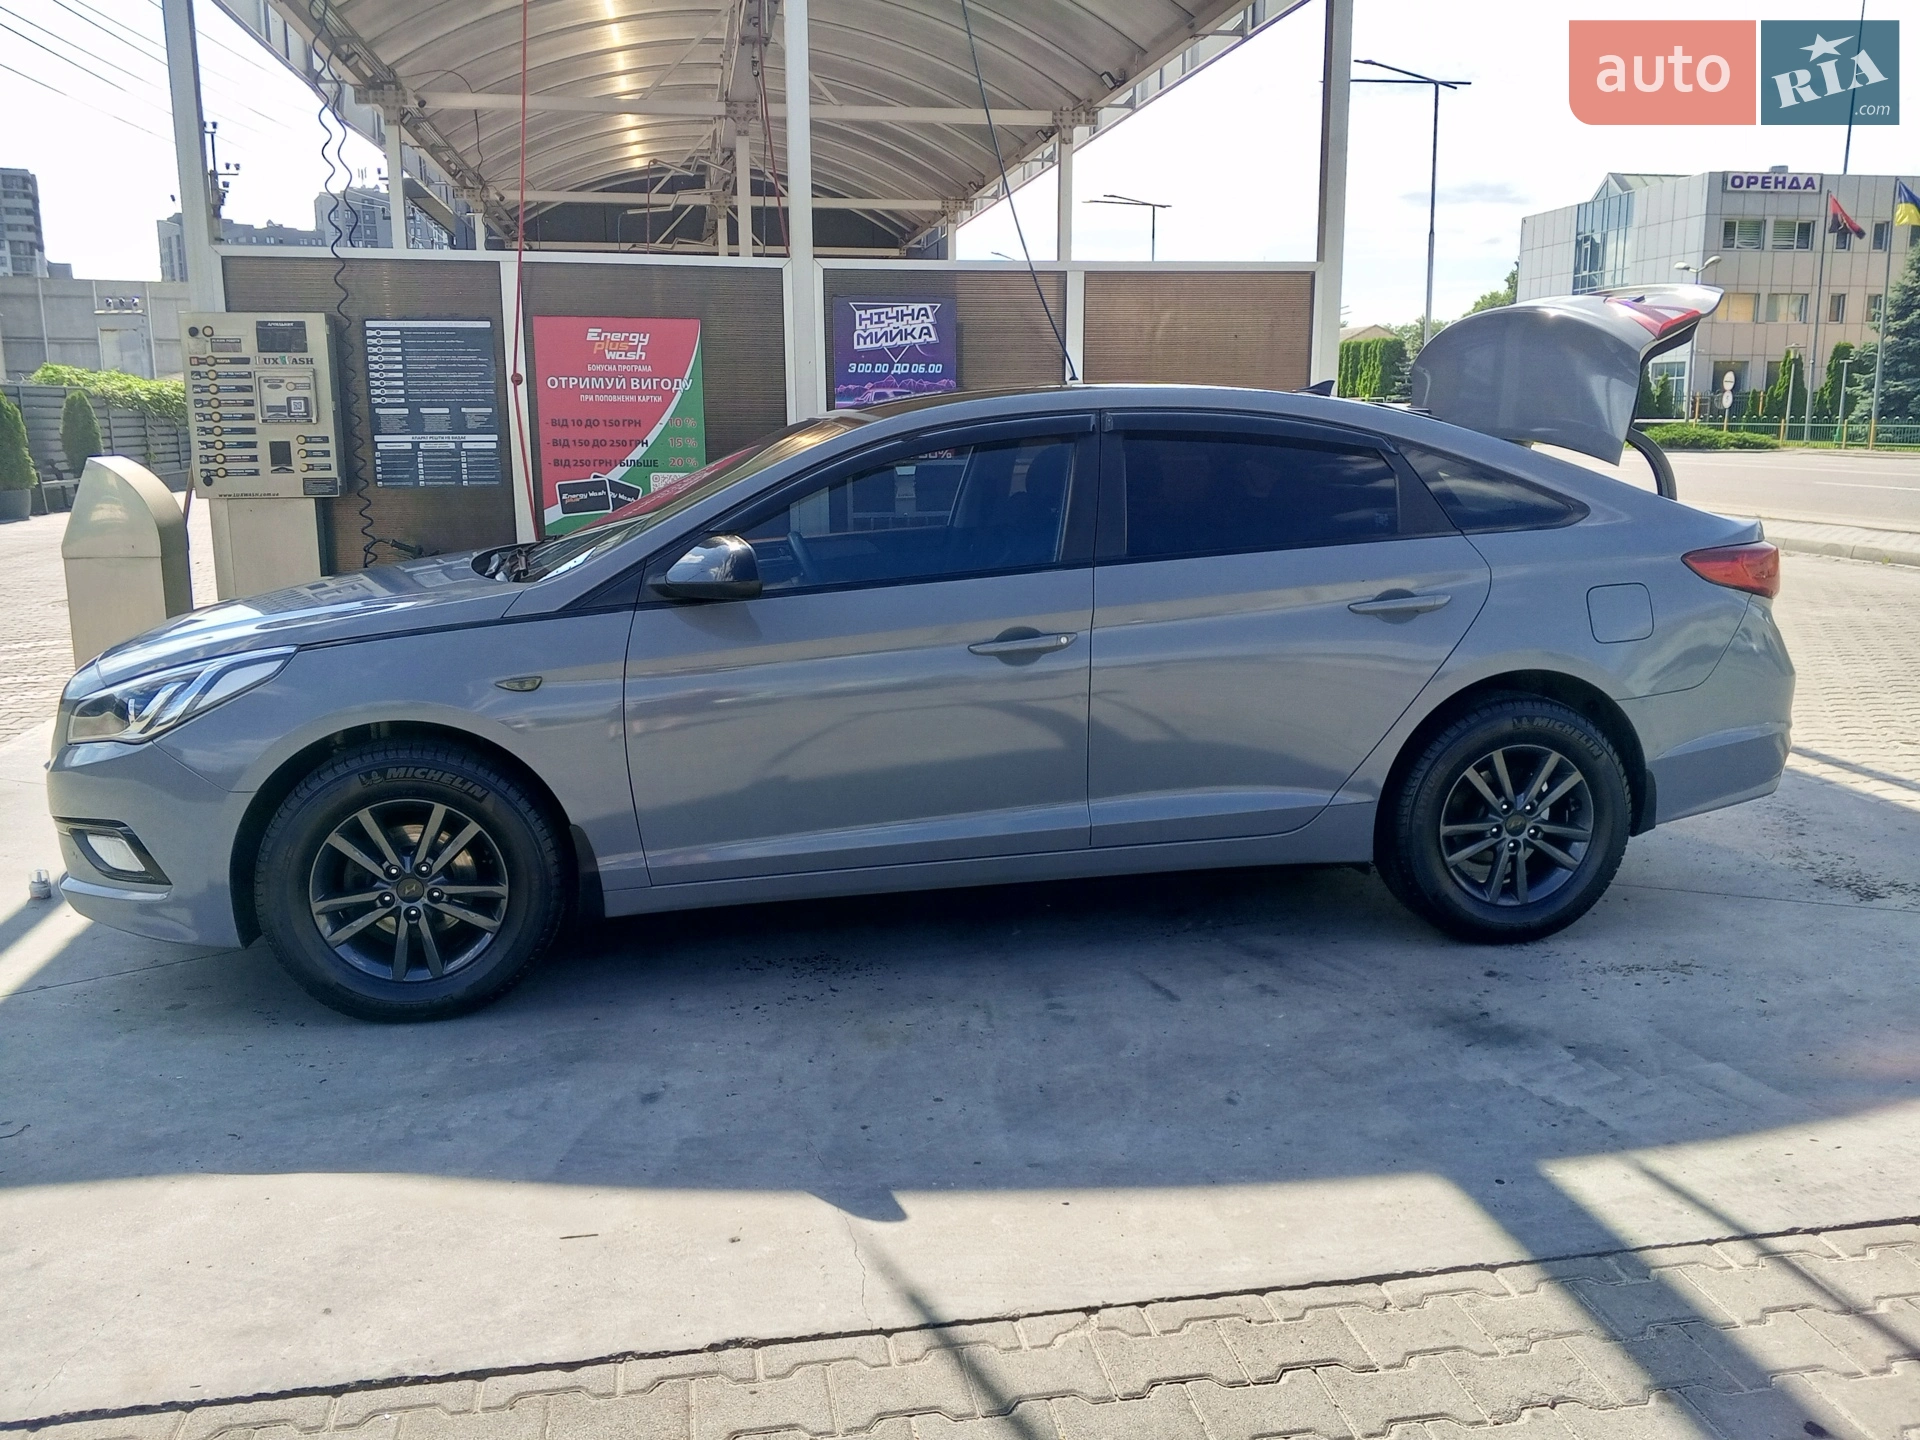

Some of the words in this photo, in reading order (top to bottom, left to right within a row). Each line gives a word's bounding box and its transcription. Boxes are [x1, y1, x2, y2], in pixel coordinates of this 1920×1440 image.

[1730, 175, 1816, 190] ОРЕНДА
[857, 306, 931, 327] НІЧНА
[586, 328, 650, 345] Energy
[856, 326, 933, 346] МИЙКА
[593, 339, 629, 354] plus
[605, 344, 646, 360] wash
[587, 364, 617, 372] БОНУСНА
[617, 364, 652, 372] ПРОГРАМА
[857, 363, 889, 373] 00.00
[891, 363, 910, 375] ДО
[911, 363, 943, 374] 06.00
[547, 375, 626, 389] ОТРИМУЙ
[630, 378, 693, 393] ВИГОДУ
[580, 394, 594, 402] ПРИ
[595, 394, 637, 402] ПОПОВНЕННІ
[637, 395, 662, 403] КАРТКИ
[551, 419, 569, 428] ВІД
[571, 419, 583, 427] 10
[584, 419, 600, 428] ДО
[603, 419, 621, 427] 150
[622, 419, 642, 427] ГРН
[668, 418, 683, 427] 10
[552, 439, 570, 448] ВІД
[572, 439, 591, 447] 150
[591, 439, 608, 449] ДО
[609, 439, 628, 447] 250
[629, 439, 649, 447] ГРН
[668, 437, 683, 447] 15
[553, 459, 571, 468] ВІД
[572, 459, 591, 467] 250
[593, 459, 612, 467] ГРН
[619, 459, 659, 467] БІЛЬШЕ
[668, 457, 684, 467] 20
[1533, 717, 1603, 757] MICHELIN
[386, 767, 488, 799] MICHELIN
